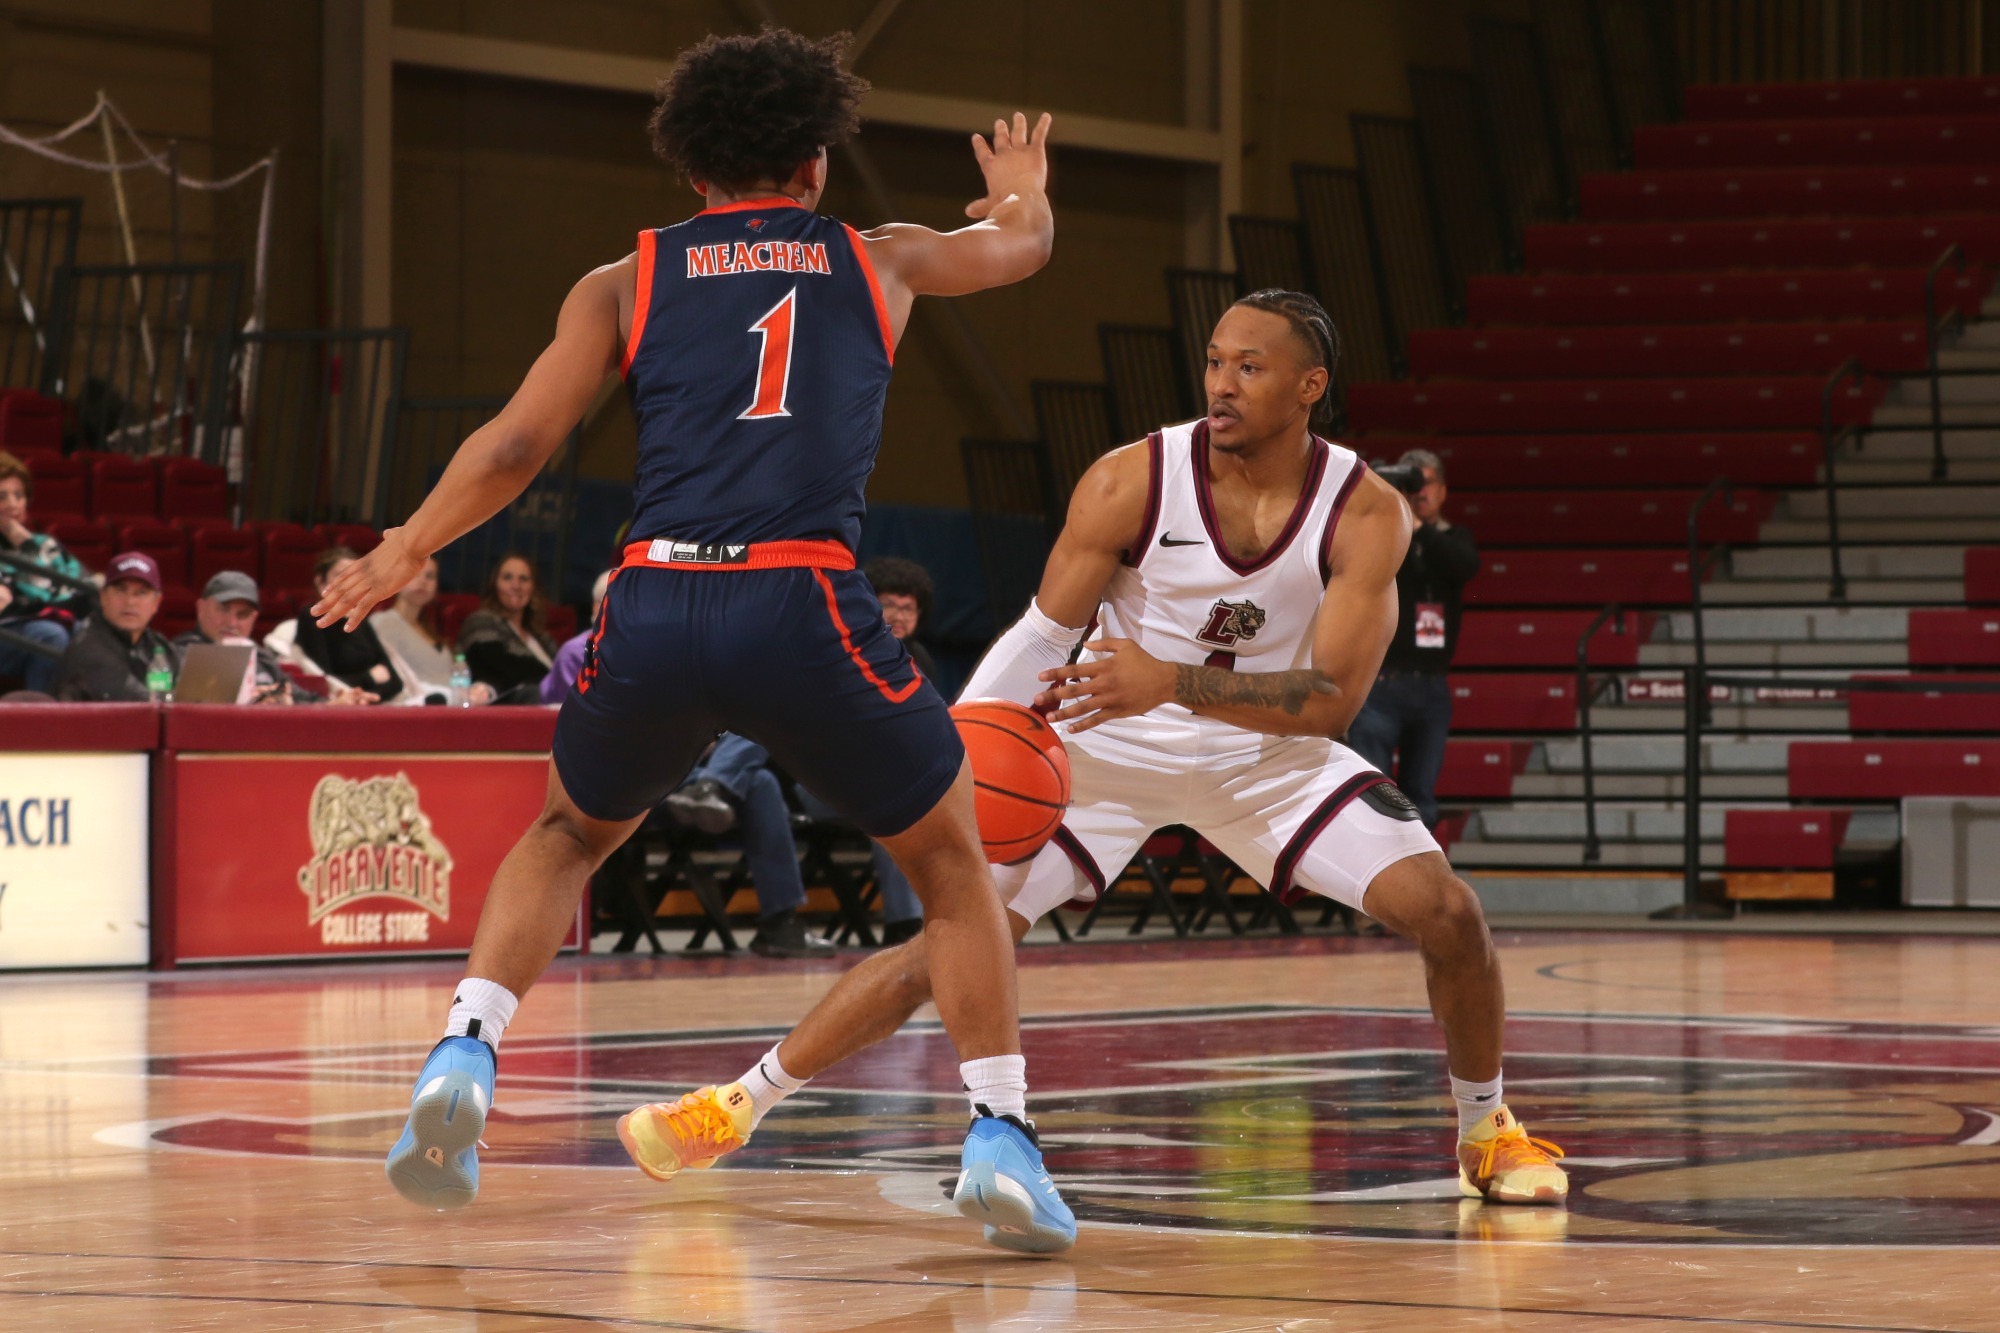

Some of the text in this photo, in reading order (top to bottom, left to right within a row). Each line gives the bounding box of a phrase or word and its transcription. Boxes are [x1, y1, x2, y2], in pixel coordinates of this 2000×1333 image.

[686, 240, 831, 278] MEACHEM
[736, 284, 796, 420] 1
[1196, 603, 1240, 647] L
[314, 845, 447, 909] LAFAYETTE
[322, 911, 430, 944] COLLEGE STORE
